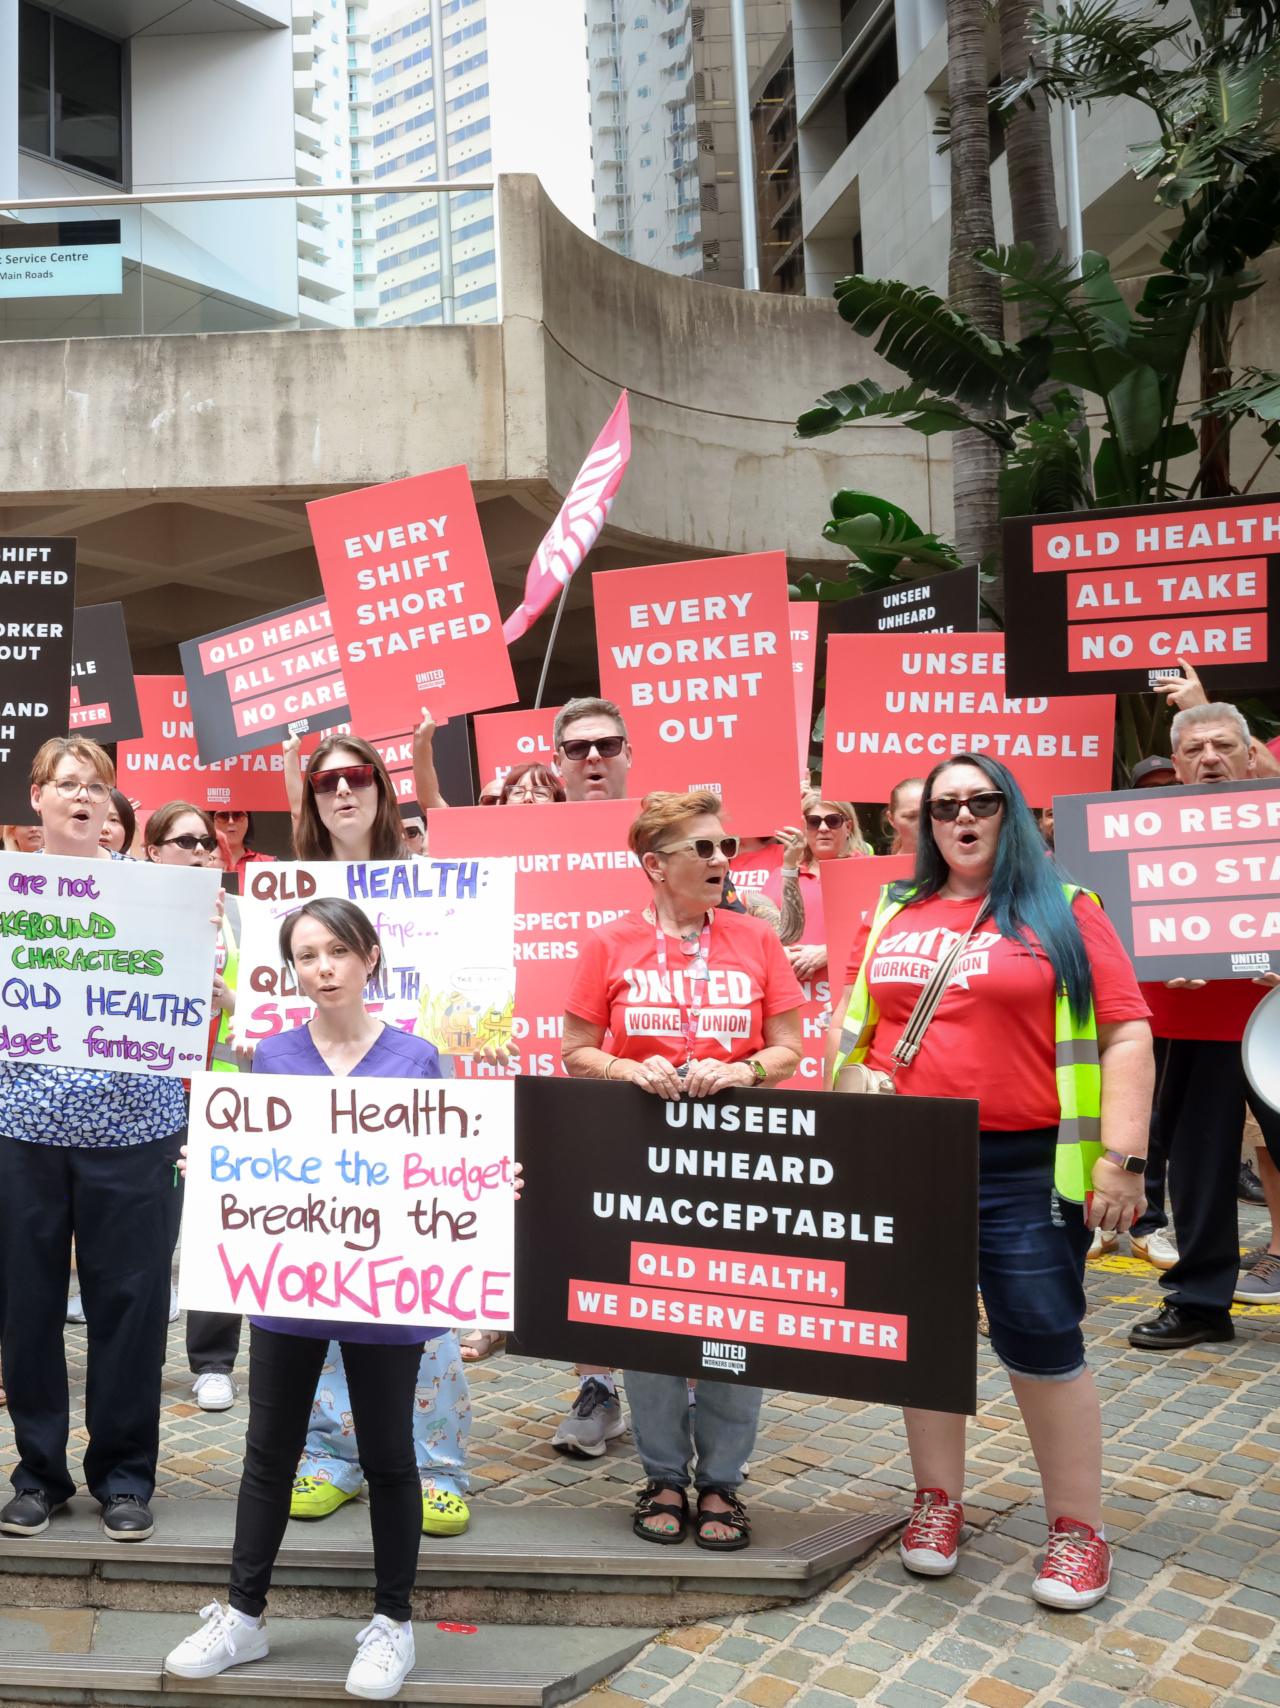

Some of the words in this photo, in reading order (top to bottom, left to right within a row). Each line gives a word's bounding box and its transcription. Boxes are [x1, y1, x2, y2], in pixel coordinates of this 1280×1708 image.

[5, 252, 47, 265] Service
[50, 251, 89, 263] Centre
[25, 269, 54, 279] Roads
[344, 515, 448, 559] EVERY
[1047, 531, 1119, 560] QLD
[1136, 516, 1280, 552] HEALTH
[356, 551, 451, 590] SHIFT
[356, 581, 466, 626] SHORT
[883, 586, 931, 608] UNSEEN
[1075, 581, 1142, 608] ALL
[1157, 571, 1256, 602] TAKE
[629, 592, 753, 628] EVERY
[878, 606, 936, 631] UNHEARD
[209, 637, 255, 664] QLD
[263, 609, 332, 647] HEALT
[348, 612, 491, 663] STAFFED
[611, 631, 777, 669] WORKER
[1082, 634, 1133, 660] NO
[1149, 626, 1252, 656] CARE
[233, 662, 275, 693] ALL
[281, 644, 340, 676] TAKE
[415, 669, 444, 683] UNITED
[902, 653, 1006, 675] UNSEE
[1148, 668, 1181, 679] UNITED
[242, 703, 275, 727] NO
[284, 681, 347, 713] CARE
[631, 672, 763, 707] BURNT
[885, 691, 1048, 714] UNHEARD
[71, 708, 107, 723] TTER
[659, 714, 738, 743] OUT
[516, 735, 551, 753] QL
[836, 732, 1099, 758] UNACCEPTABLE
[207, 788, 230, 796] UNITED
[1104, 811, 1162, 838] NO
[1180, 802, 1280, 833] RESP
[567, 850, 643, 871] PATIEN
[1137, 861, 1198, 889] NO
[9, 873, 47, 896] are
[58, 875, 100, 899] not
[251, 870, 317, 901] QLD
[346, 861, 489, 900] HEALTH:
[514, 910, 581, 931] SPECT
[1149, 916, 1211, 943] NO
[12, 946, 164, 976] CHARACTERS
[873, 961, 934, 979] WORKER
[1231, 952, 1270, 964] UNITED
[2, 977, 61, 1010] QLD
[86, 985, 206, 1026] HEALTHS
[623, 969, 752, 1005] UNITED
[629, 1012, 680, 1031] WORKE
[702, 1014, 747, 1032] UNION
[83, 1026, 203, 1070] fantasy...
[459, 1054, 523, 1077] THIS
[527, 1053, 555, 1076] IS
[205, 1087, 292, 1132] QLD
[331, 1088, 483, 1138] Health:
[665, 1101, 816, 1137] UNSEEN
[210, 1145, 323, 1184] Broke
[335, 1148, 390, 1187] the
[403, 1153, 514, 1201] Budget,
[648, 1147, 834, 1185] UNHEARD
[221, 1193, 381, 1251] Breaking
[407, 1197, 478, 1242] the
[593, 1192, 894, 1244] UNACCEPTABLE
[217, 1242, 511, 1322] WORKFORCE
[637, 1253, 696, 1278] QLD
[708, 1259, 839, 1299] HEALTH,
[577, 1290, 618, 1316] WE
[630, 1296, 764, 1333] DESERVE
[778, 1312, 899, 1348] BETTER
[702, 1341, 747, 1360] UNITED
[727, 1361, 744, 1370] UNION
